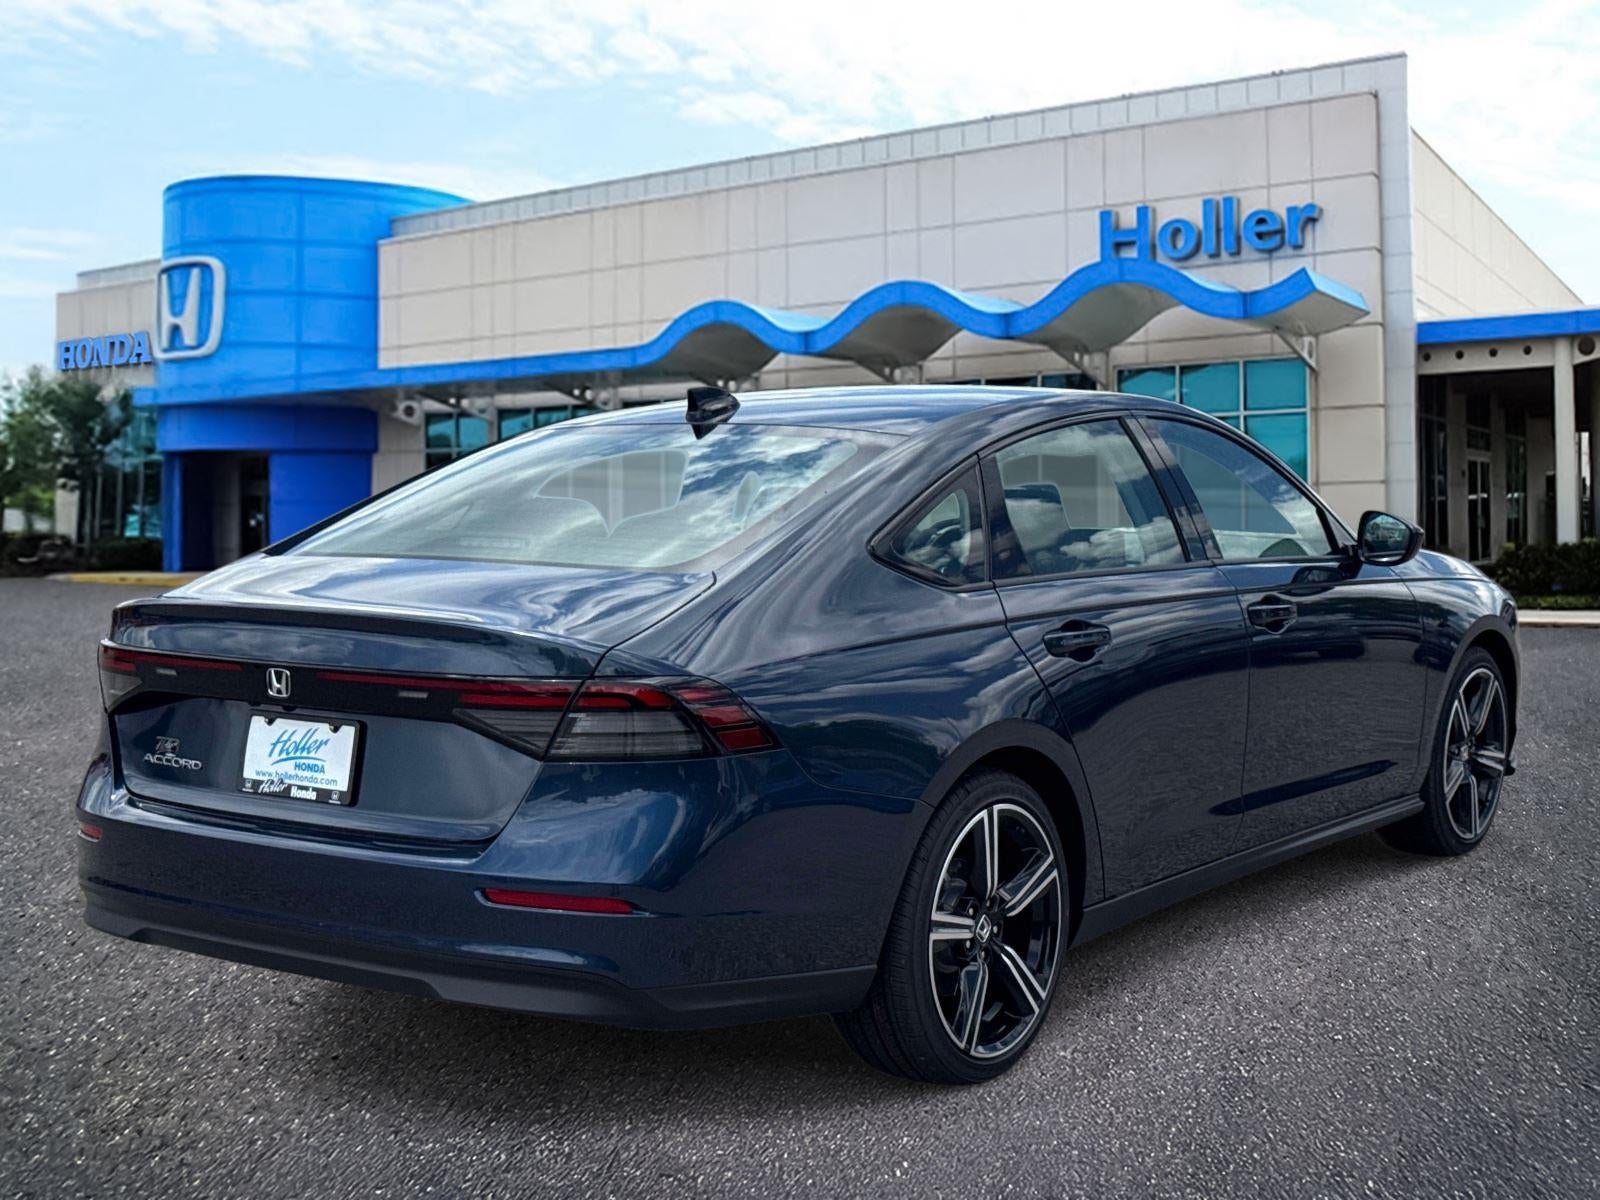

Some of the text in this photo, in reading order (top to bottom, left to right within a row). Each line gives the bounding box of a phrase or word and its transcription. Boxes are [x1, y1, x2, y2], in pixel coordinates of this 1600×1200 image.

[1099, 196, 1320, 261] Holler
[57, 331, 152, 370] HONDA
[268, 728, 331, 758] Holler
[143, 752, 202, 770] ACCORD
[294, 761, 326, 774] HONDA
[255, 769, 338, 787] www.hollerhonda.com
[290, 785, 317, 800] Honda
